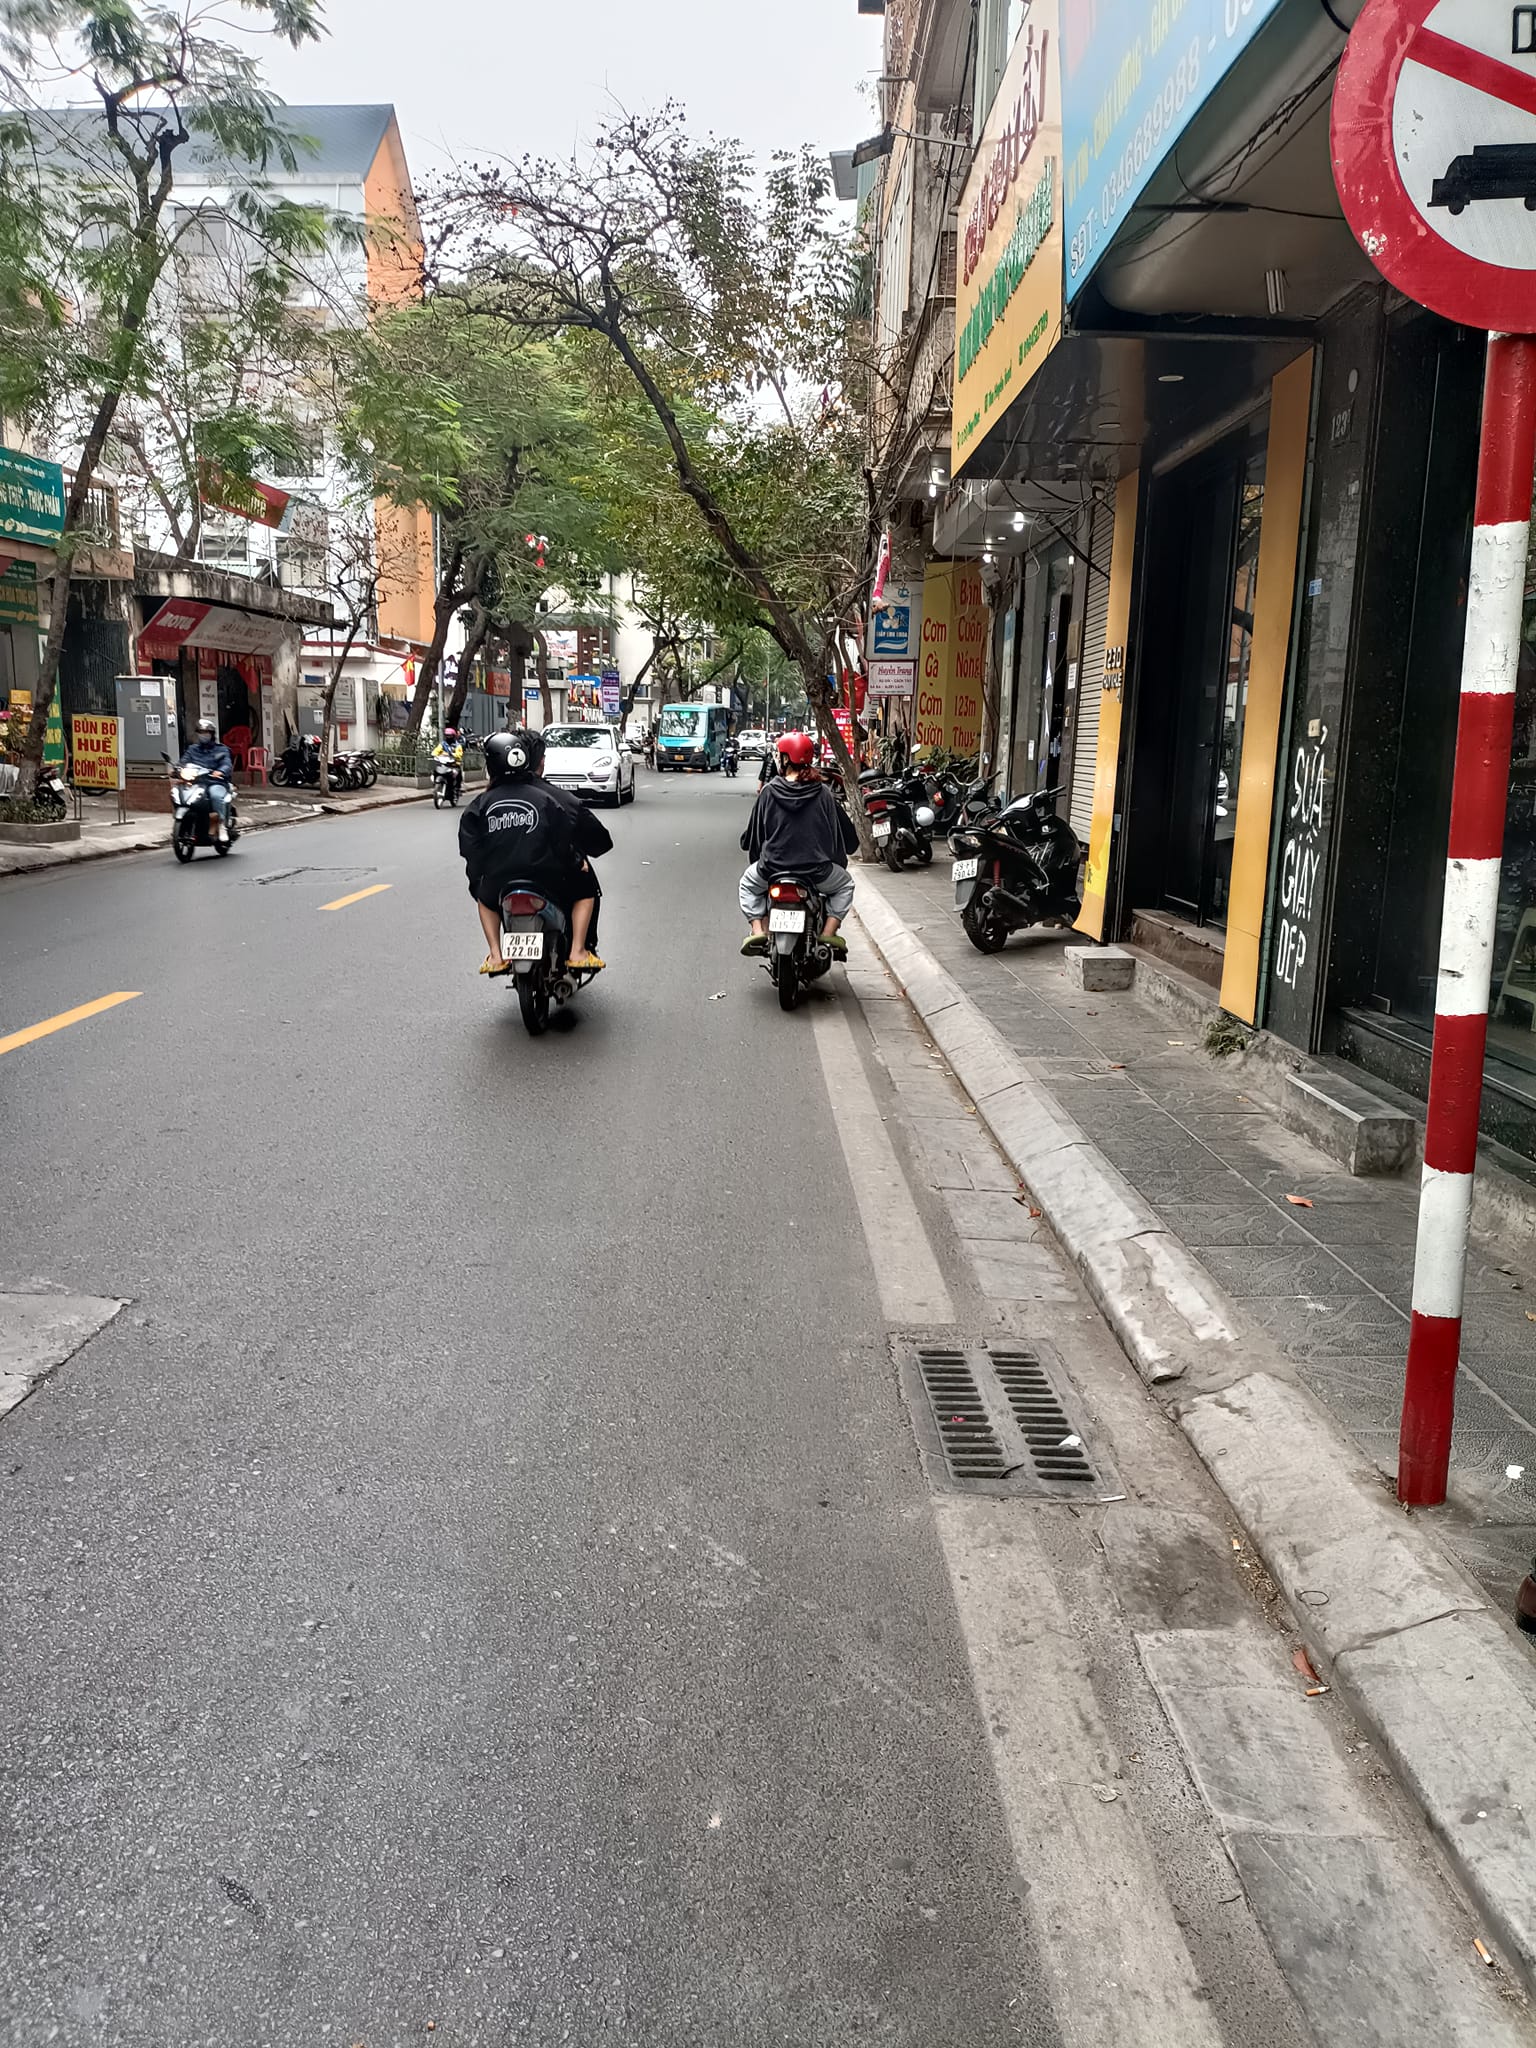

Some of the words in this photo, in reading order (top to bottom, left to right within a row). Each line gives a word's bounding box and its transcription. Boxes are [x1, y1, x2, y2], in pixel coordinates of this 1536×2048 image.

[1102, 35, 1200, 229] 0346689988
[923, 617, 947, 643] Cơm
[925, 651, 939, 678] Gà
[919, 691, 942, 716] Cơm
[77, 736, 112, 754] HUẾ
[74, 757, 96, 778] CƠM
[488, 810, 534, 833] Drifted
